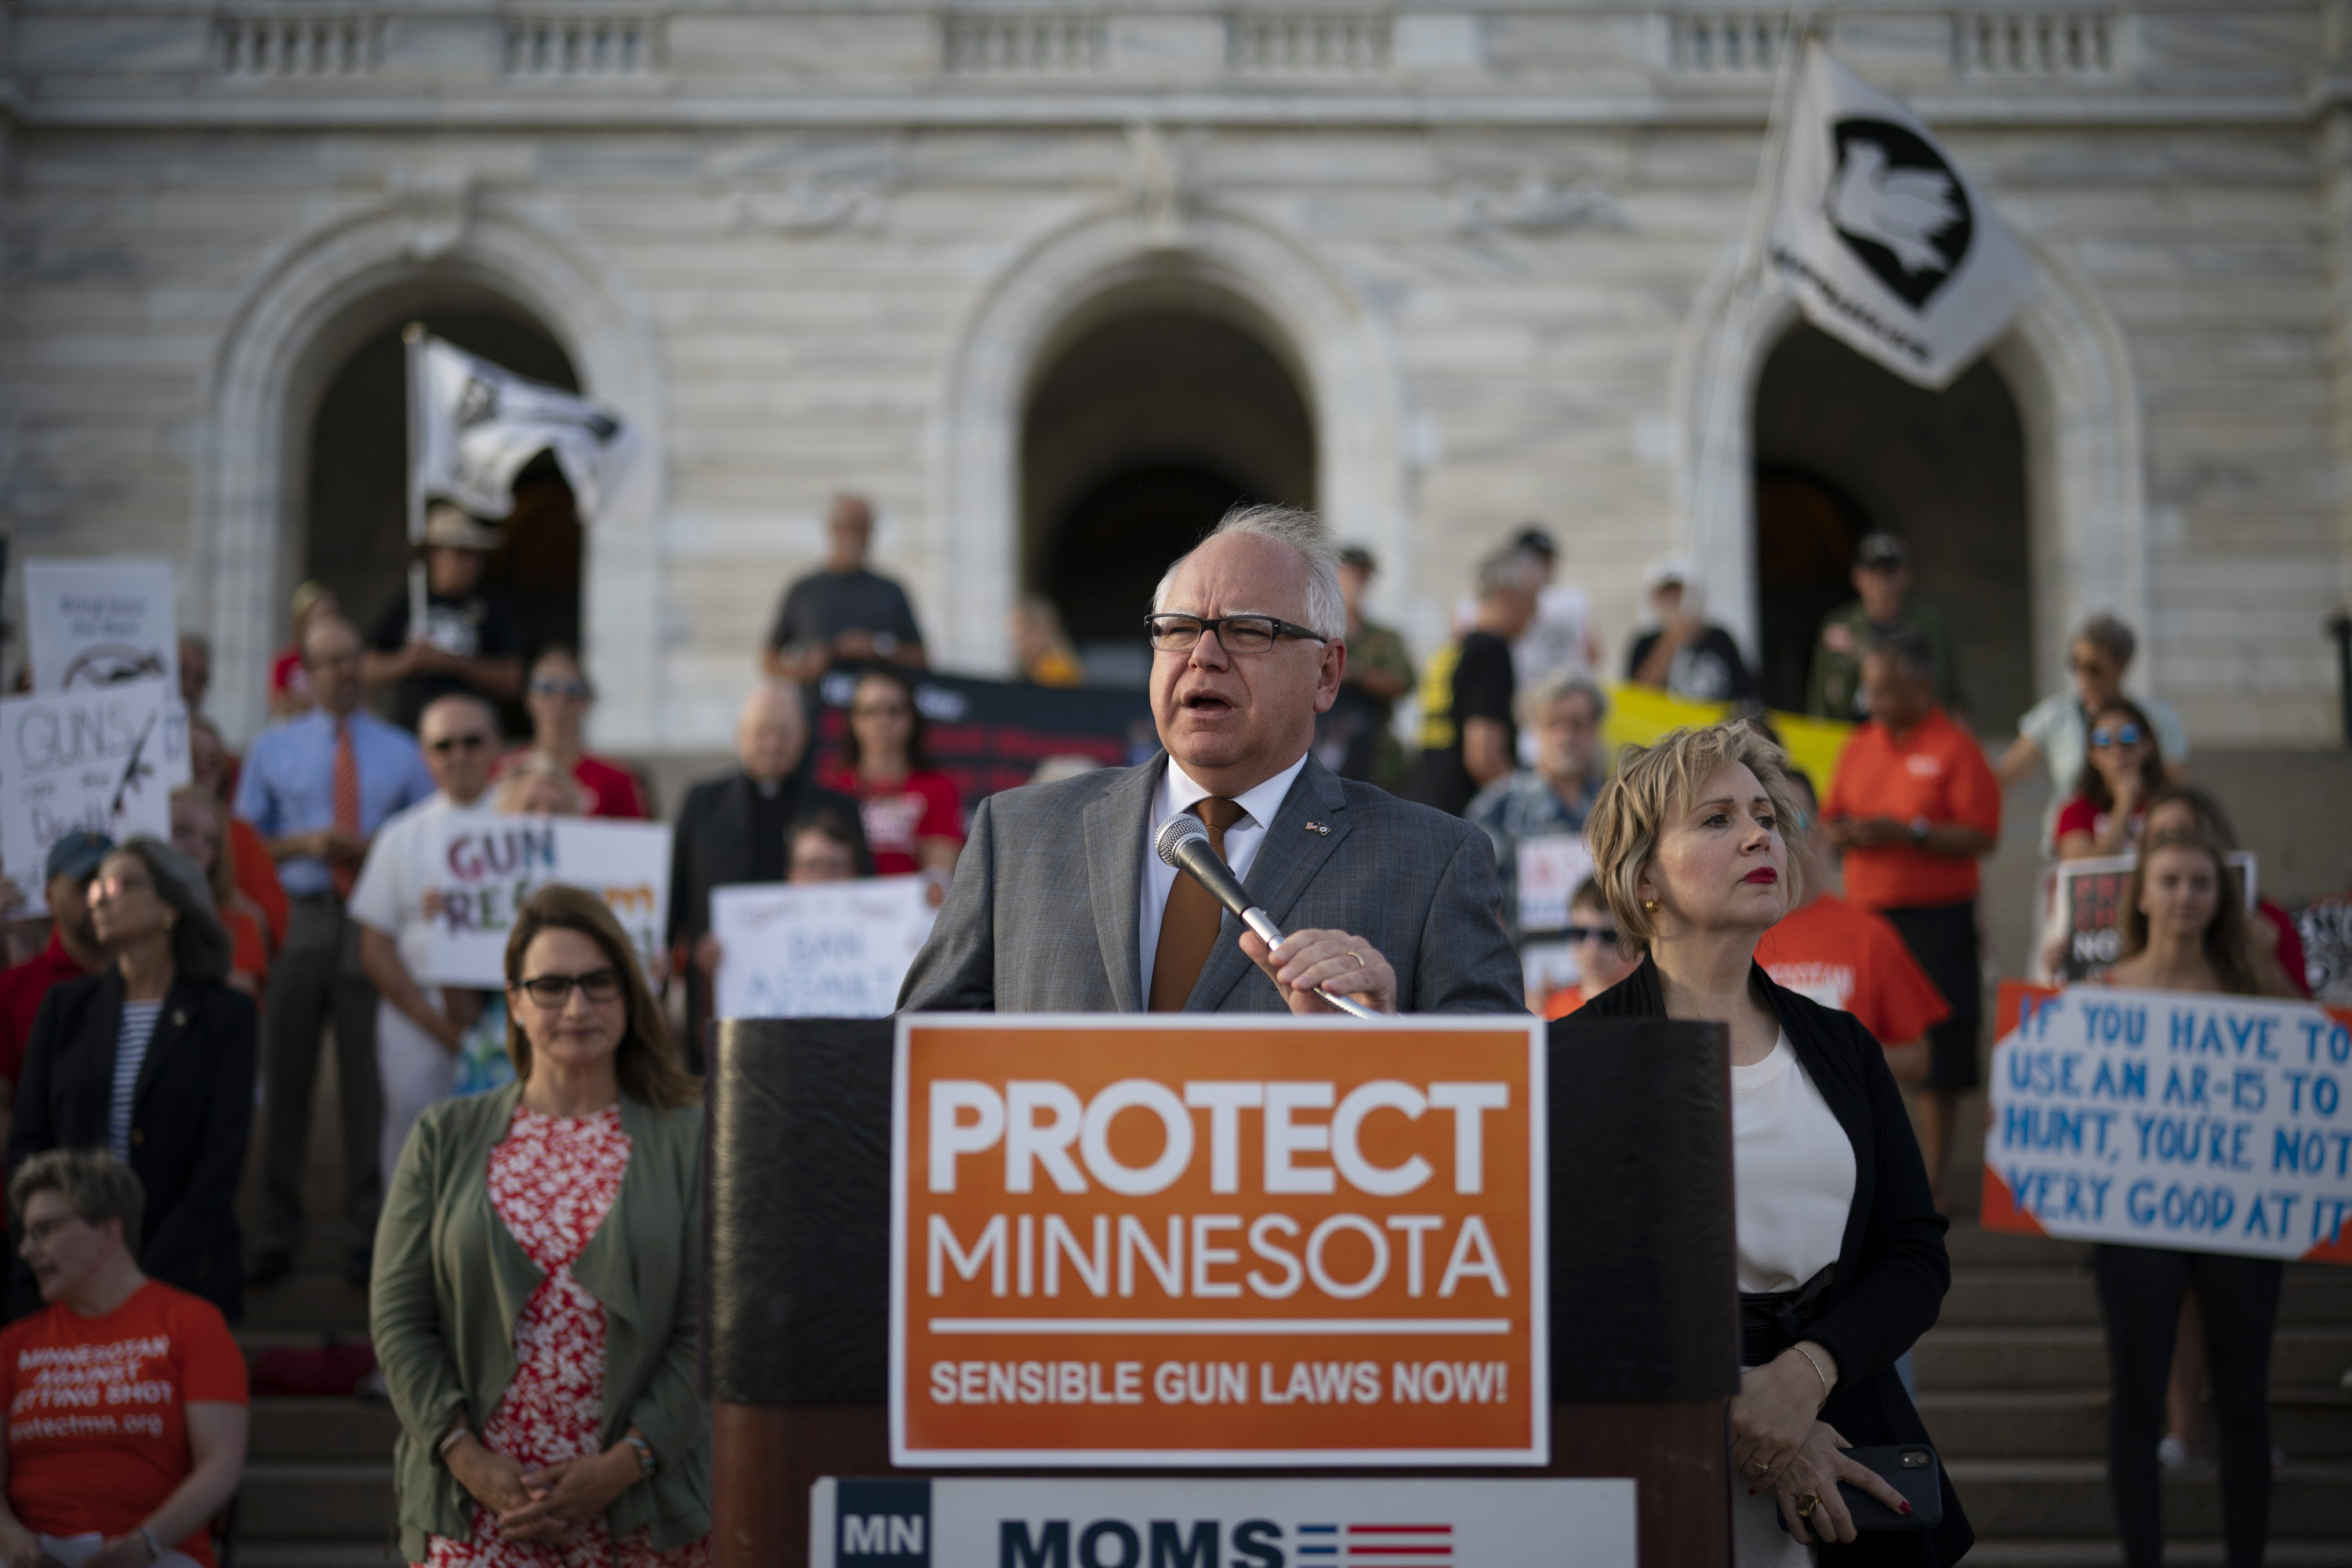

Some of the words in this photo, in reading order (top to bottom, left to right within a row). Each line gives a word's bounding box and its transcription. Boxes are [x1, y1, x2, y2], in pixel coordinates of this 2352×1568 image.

[16, 698, 136, 772] GUNS
[448, 826, 554, 881] GUN
[2020, 996, 2063, 1040] IF
[2080, 999, 2147, 1047] YOU
[2169, 1006, 2279, 1061] HAVE
[2298, 1021, 2351, 1064] TO
[2008, 1050, 2082, 1098] USE
[2090, 1059, 2147, 1101] AN
[2161, 1063, 2267, 1114] AR-15
[2283, 1070, 2339, 1119] TO
[928, 1078, 1510, 1196] PROTECT
[2003, 1104, 2120, 1164] HUNT,
[2131, 1110, 2252, 1171] YOU'RE
[2272, 1126, 2352, 1180] NOT
[2005, 1163, 2113, 1225] VERY
[2125, 1178, 2235, 1231] GOOD
[2243, 1191, 2301, 1242] AT
[2310, 1196, 2352, 1247] IT
[927, 1212, 1510, 1299] MINNESOTA
[104, 1379, 173, 1405] SHOT
[929, 1360, 1144, 1404] SENSIBLE
[1152, 1360, 1249, 1404] GUN
[1259, 1360, 1382, 1405] LAWS
[1391, 1360, 1509, 1404] NOW!
[843, 1514, 924, 1555] MN
[998, 1518, 1284, 1568] MOMS
